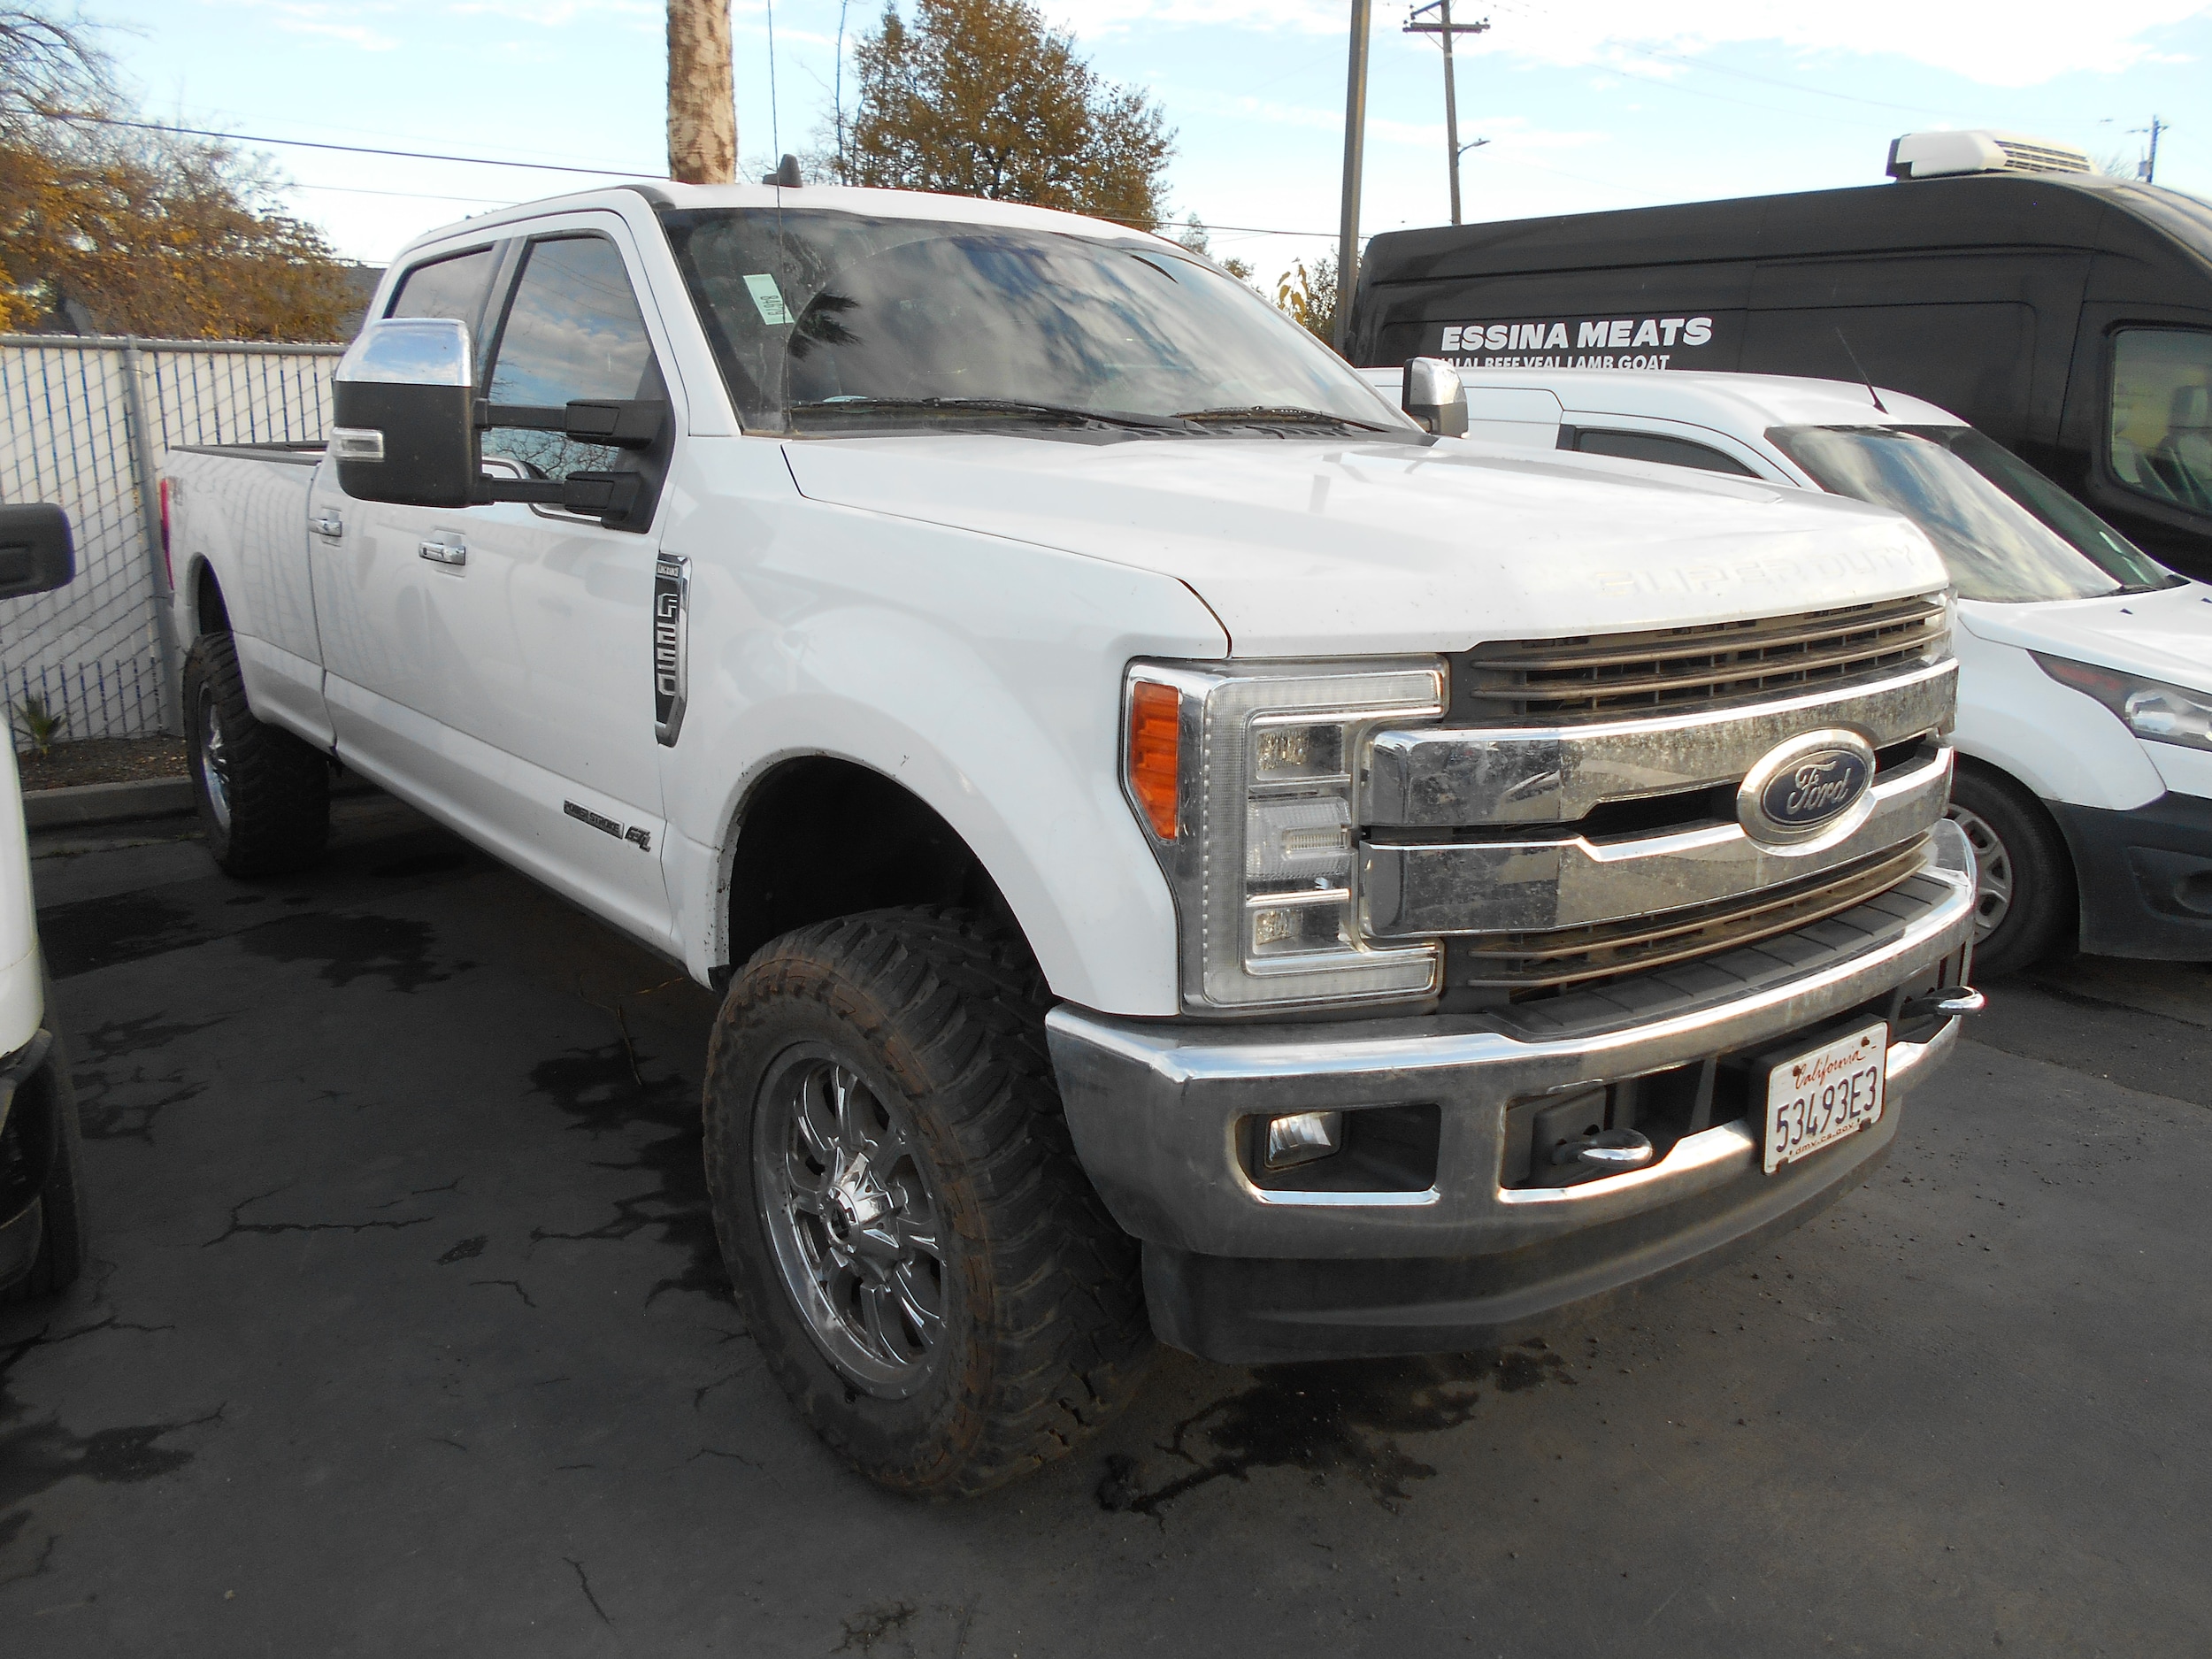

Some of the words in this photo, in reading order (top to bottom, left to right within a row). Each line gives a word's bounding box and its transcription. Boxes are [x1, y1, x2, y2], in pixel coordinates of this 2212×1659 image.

[1441, 323, 1569, 351] ESSINA
[1577, 317, 1713, 349] MEATS
[1617, 354, 1670, 371] GOAT
[1594, 558, 1805, 597] SUPER
[1814, 545, 1916, 579] DUTY
[1786, 761, 1851, 815] Ford
[1794, 1049, 1866, 1089] California
[1775, 1065, 1878, 1153] 53493E3
[1794, 1121, 1855, 1156] dmv.ca.gov
